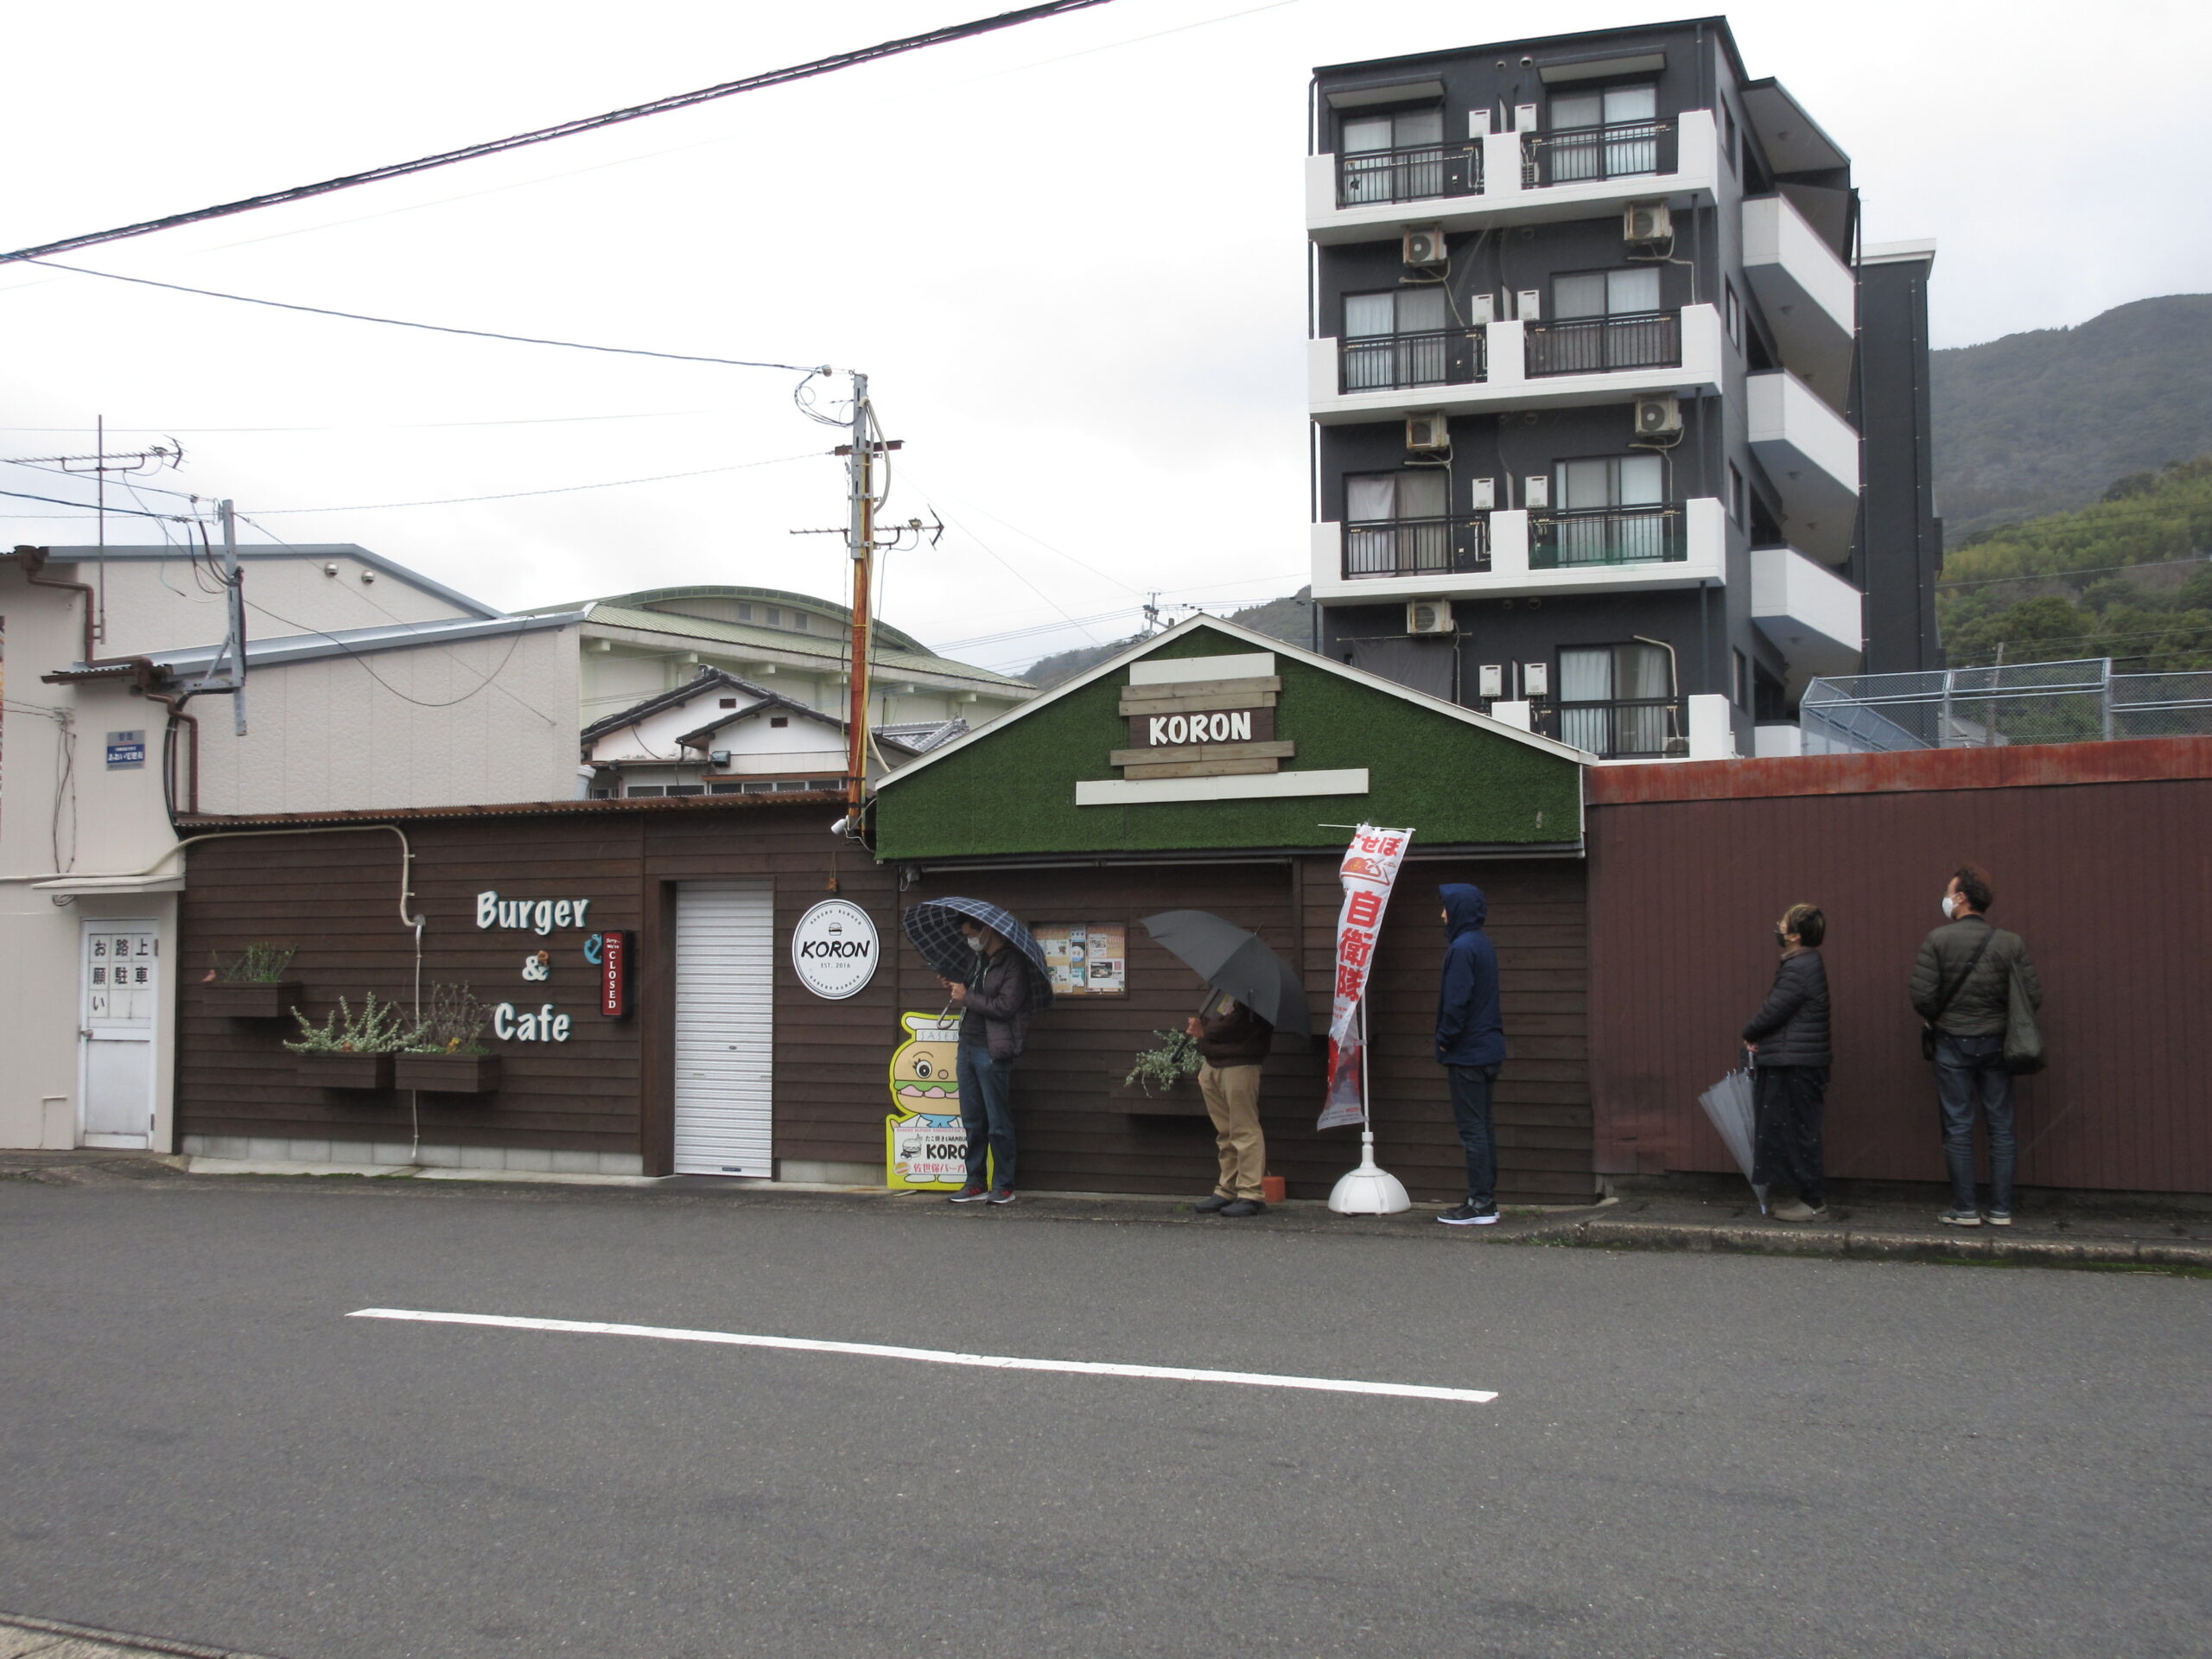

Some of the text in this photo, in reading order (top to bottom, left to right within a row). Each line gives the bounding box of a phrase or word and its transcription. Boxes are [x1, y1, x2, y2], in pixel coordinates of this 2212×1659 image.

[1149, 711, 1251, 746] KORON
[477, 890, 590, 936] Burger
[801, 940, 870, 959] KORON
[1337, 890, 1383, 1002] 自衛隊
[522, 954, 550, 982] &
[607, 951, 617, 1009] CLOSED
[494, 1002, 571, 1042] Cafe
